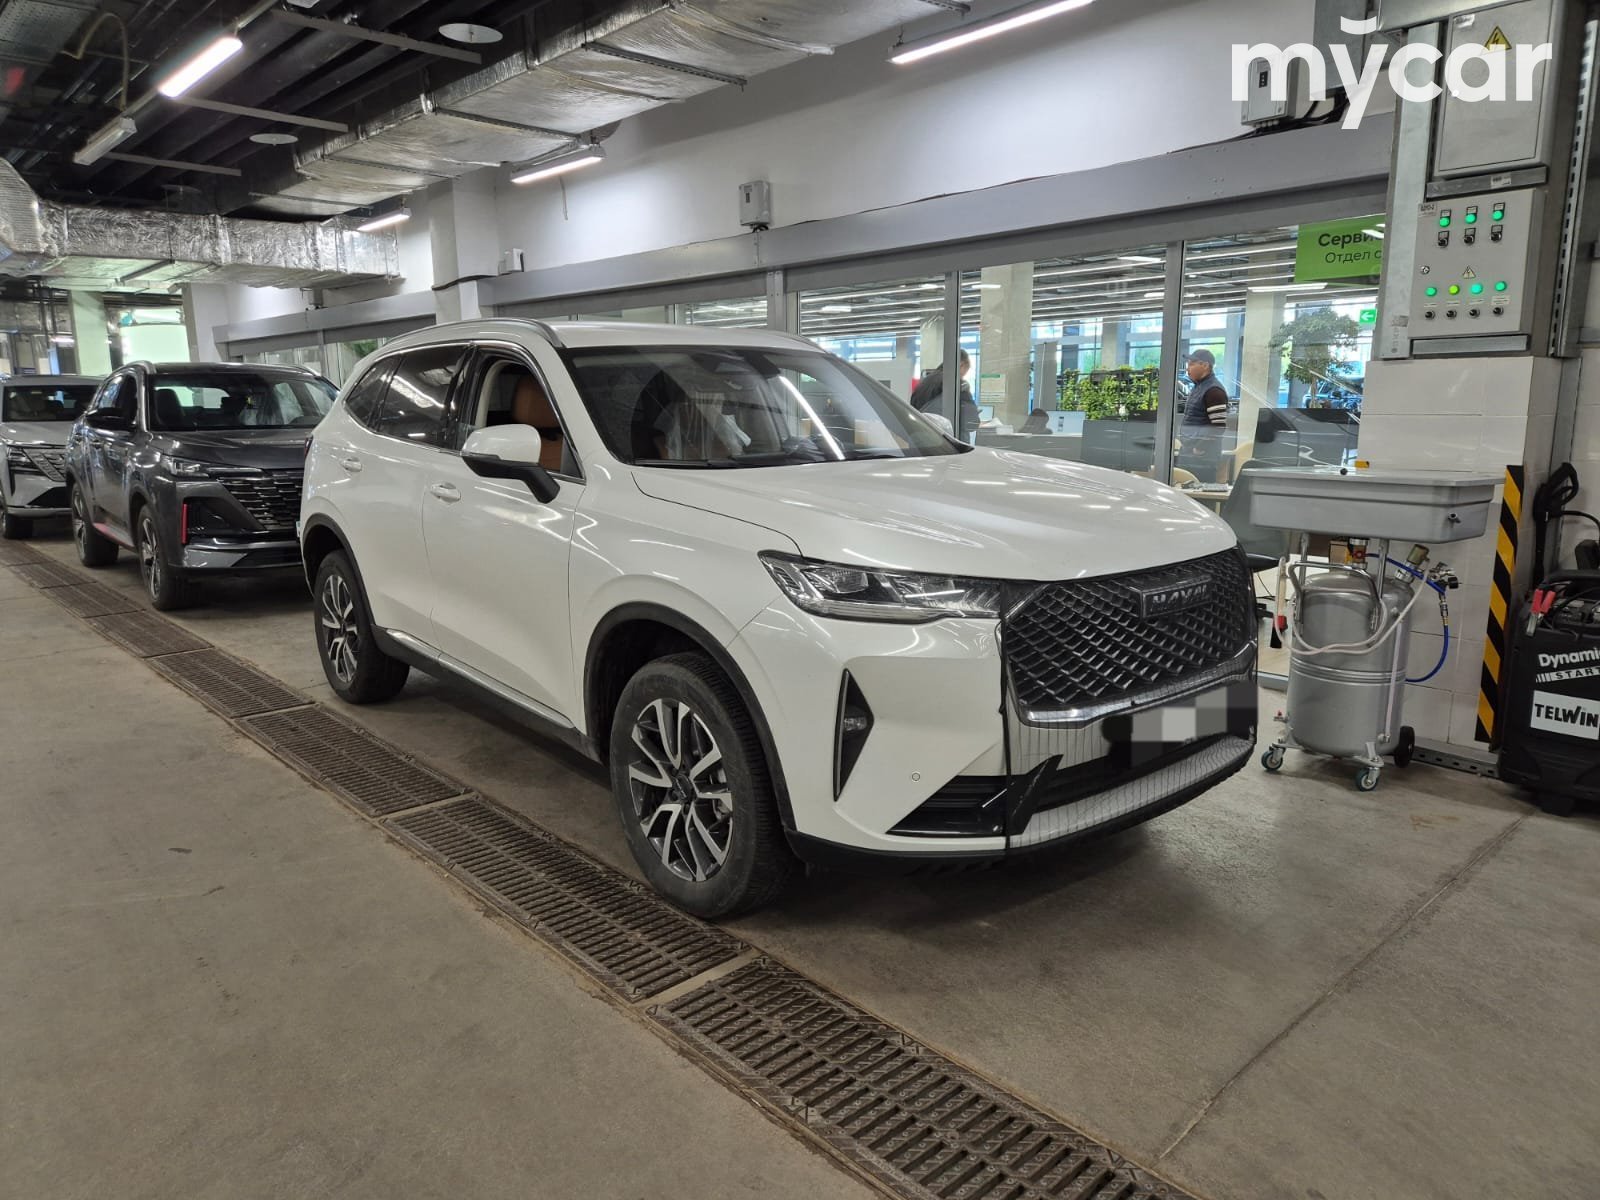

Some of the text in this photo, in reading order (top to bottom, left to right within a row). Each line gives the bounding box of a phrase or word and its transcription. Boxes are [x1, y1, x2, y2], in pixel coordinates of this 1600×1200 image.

[1325, 251, 1370, 264] Отдел
[1538, 647, 1600, 668] Dynami
[1534, 703, 1599, 728] TELWIN
